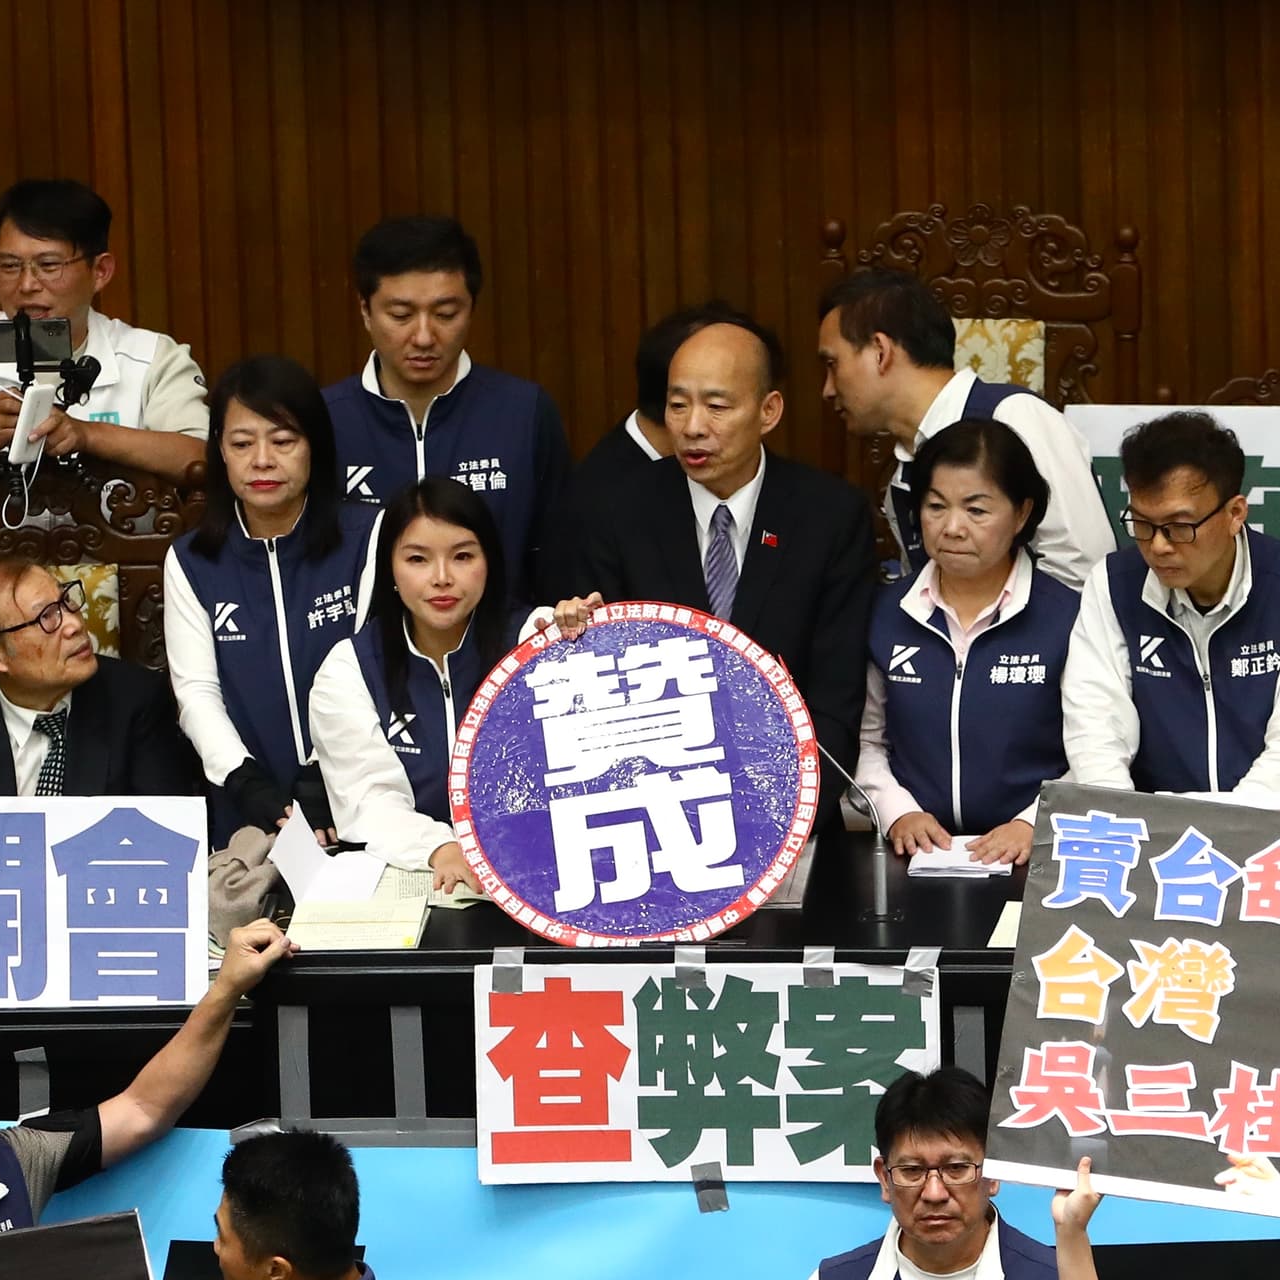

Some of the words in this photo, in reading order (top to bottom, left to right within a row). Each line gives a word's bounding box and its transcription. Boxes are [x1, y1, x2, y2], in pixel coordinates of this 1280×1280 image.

[458, 458, 500, 471] 立法委員
[999, 654, 1040, 664] 立法委員
[1240, 641, 1274, 655] 立法委員
[525, 635, 746, 914] 贊成
[1031, 924, 1237, 1044] 台灣
[487, 975, 926, 1166] 查弊案
